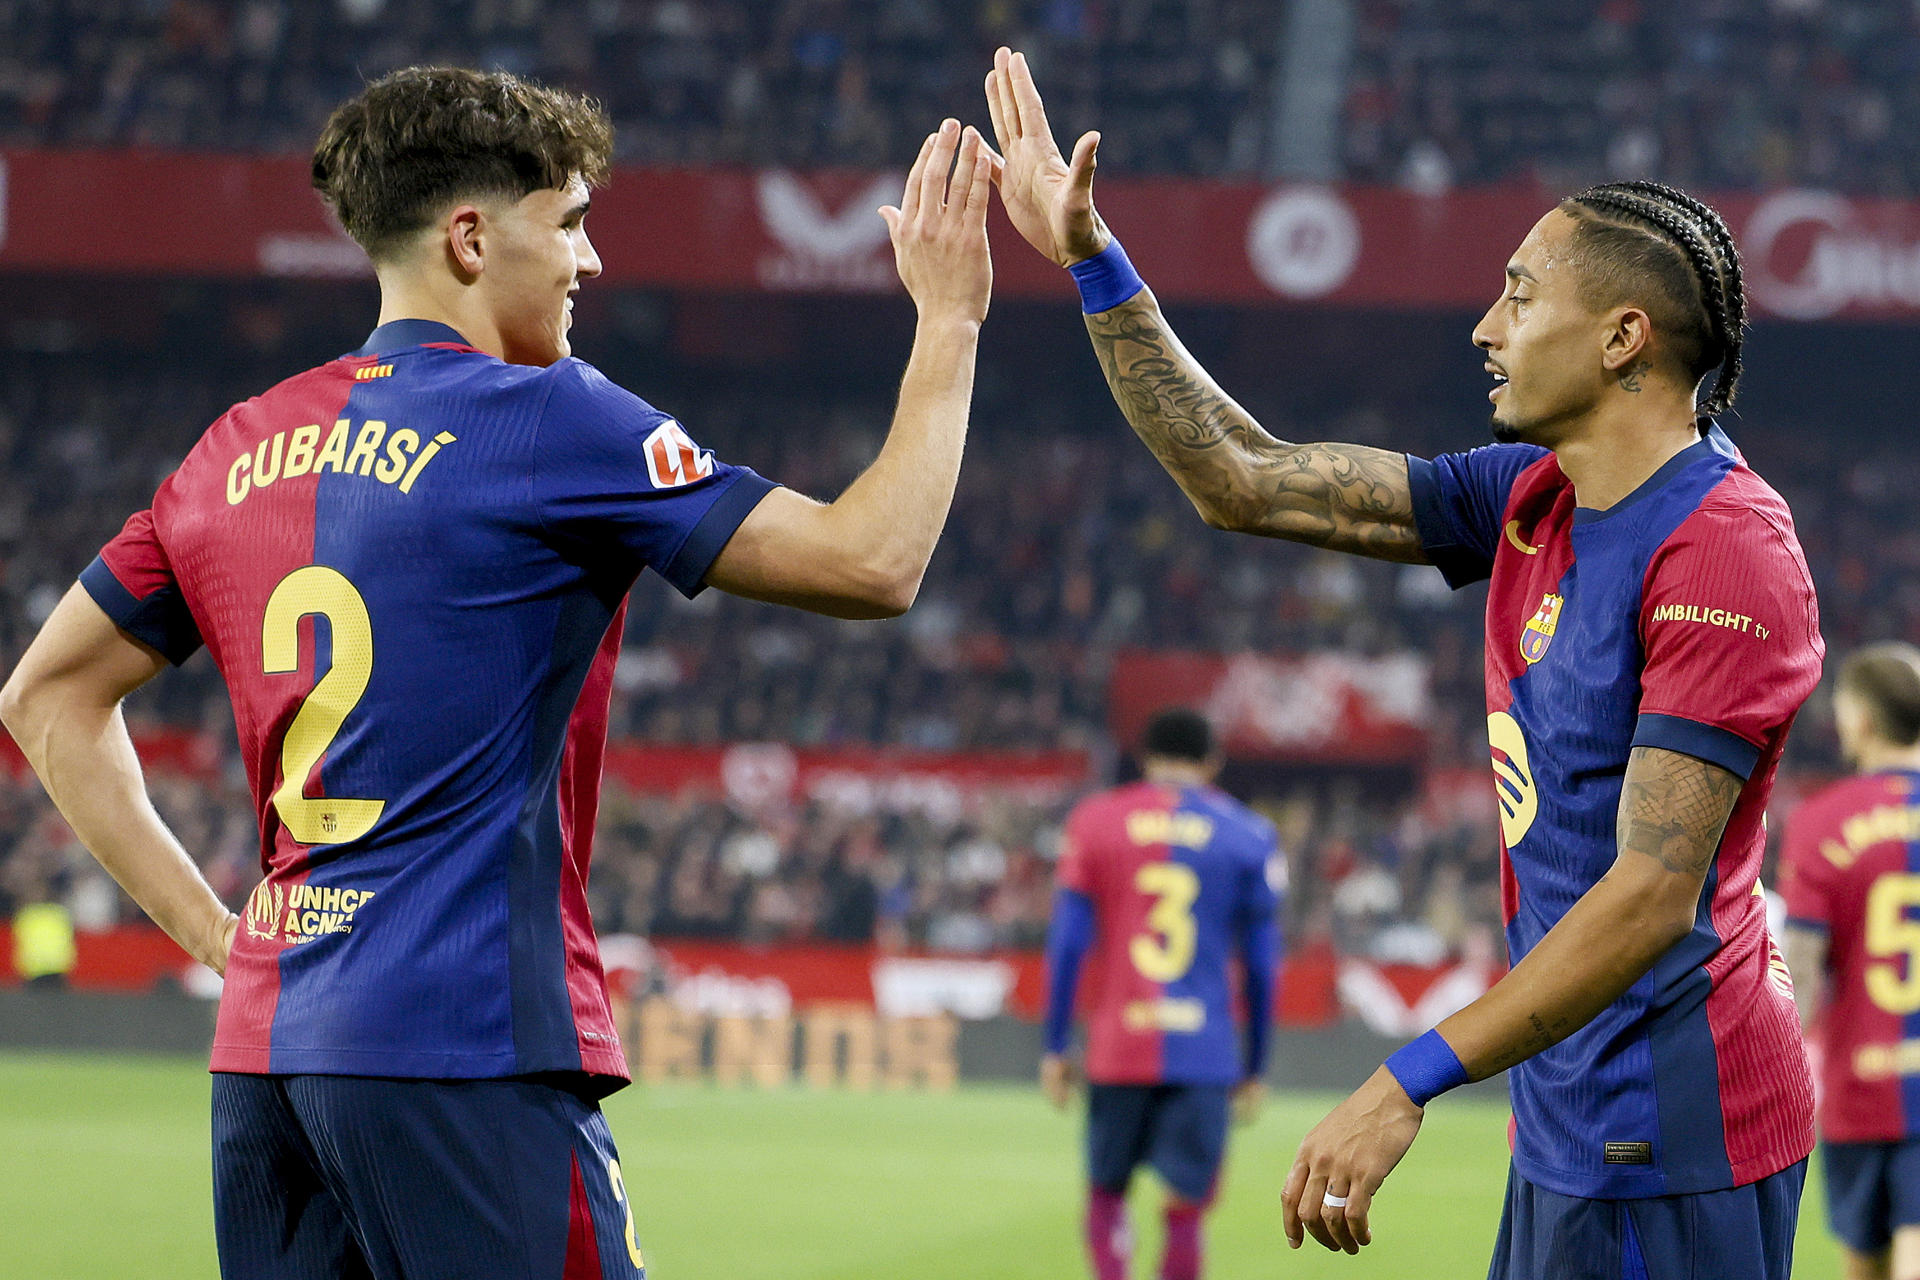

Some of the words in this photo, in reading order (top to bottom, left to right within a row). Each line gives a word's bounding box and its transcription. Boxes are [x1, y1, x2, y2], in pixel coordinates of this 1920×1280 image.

[226, 418, 458, 506] CUBARSÍ
[1652, 604, 1752, 633] AMBILIGHT
[1755, 622, 1771, 640] tv
[261, 564, 386, 845] 2
[1129, 861, 1199, 978] 3
[1865, 871, 1920, 1015] 5
[609, 1158, 645, 1269] 2
